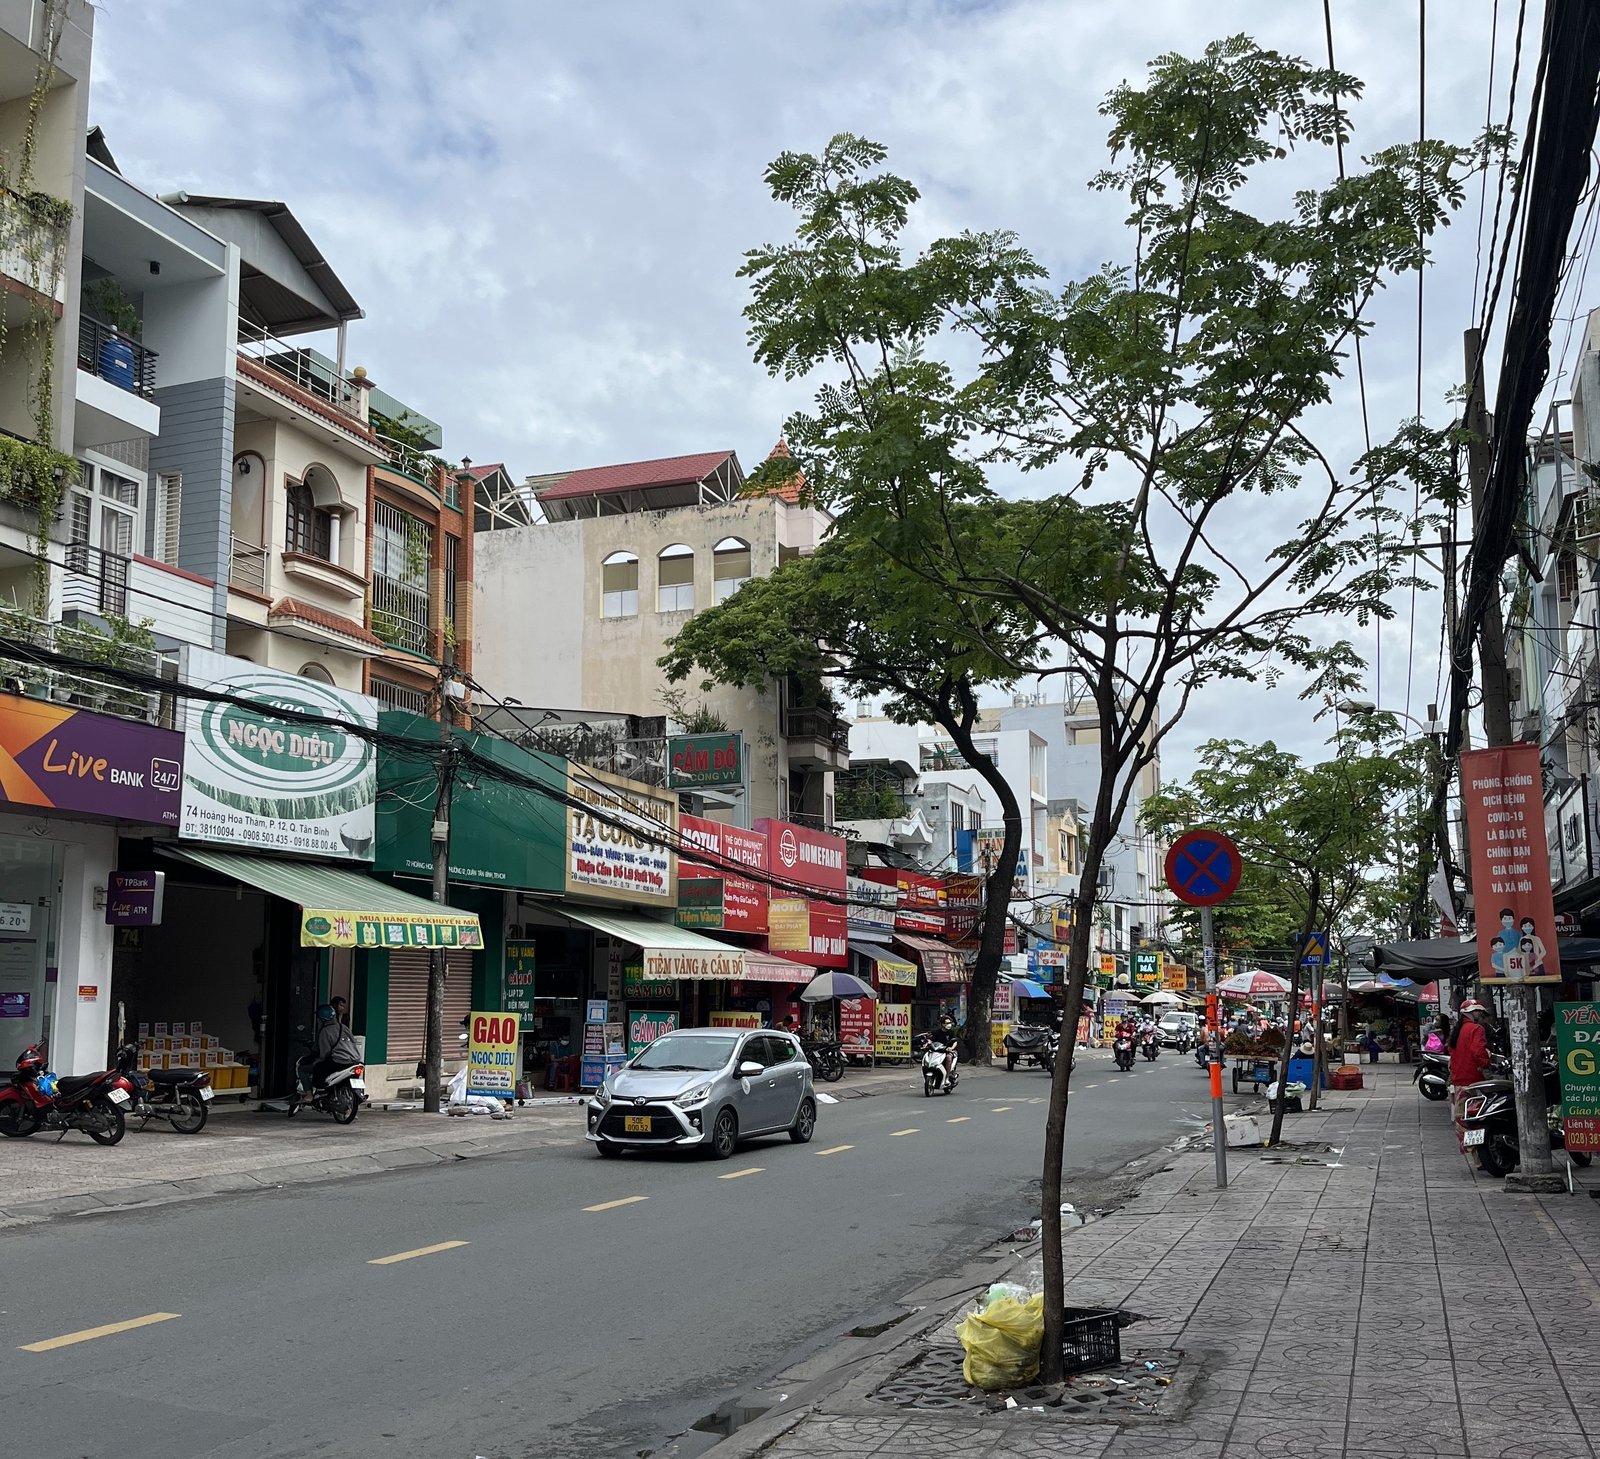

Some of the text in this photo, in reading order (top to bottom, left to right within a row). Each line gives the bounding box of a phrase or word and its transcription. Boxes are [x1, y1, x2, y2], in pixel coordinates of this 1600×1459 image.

[228, 719, 335, 768] NGỌC DIỆU
[43, 738, 145, 788] Live BANK
[673, 741, 737, 772] CẦM ĐỒ
[153, 771, 178, 786] 24/7
[1472, 772, 1533, 790] PHÒNG, CHỐNG
[1482, 792, 1526, 809] DỊCH BỆNH
[186, 804, 198, 817] 74
[200, 809, 226, 824] Hoàng
[227, 813, 243, 825] Hoa
[269, 819, 276, 829] P.
[289, 822, 298, 833] Q.
[299, 824, 312, 834] Tân
[313, 826, 330, 837] Bình
[1487, 811, 1524, 823] COVID-19
[185, 822, 338, 851] ĐT: 38110094 0908.503.435 0918.88.00.46
[680, 827, 720, 853] MOTUL
[1487, 827, 1527, 841] LÀ BẢO VỆ
[572, 842, 587, 854] MUA
[799, 841, 842, 870] HOMEFARM
[1487, 845, 1531, 859] CHÍNH BẠN
[742, 850, 762, 868] PHÁT
[613, 864, 623, 878] Đồ
[1492, 863, 1528, 876] GIA ĐÌNH
[124, 878, 149, 887] TPBank
[1491, 879, 1532, 894] VÀ XÃ HỘI
[133, 906, 147, 914] ATM
[771, 903, 807, 912] MOTUL
[383, 915, 408, 923] HÀNG
[411, 915, 423, 923] CÓ
[679, 907, 721, 925] Tiệm Vàng
[951, 915, 974, 932] TỊNH
[121, 928, 140, 946] 74
[813, 933, 846, 957] NHẬP KHẨU
[647, 952, 743, 978] TIỆM VÀNG & CẦM ĐỒ
[1137, 955, 1156, 963] RAU
[1307, 955, 1321, 963] CHỢ
[1509, 957, 1524, 970] 5K
[624, 963, 643, 980] TIỆ
[1139, 963, 1154, 972] MÁ
[625, 979, 653, 998] CẦM
[655, 980, 673, 998] ĐỒ
[712, 1017, 734, 1027] THAY
[878, 1006, 909, 1027] CẦM ĐỒ
[1561, 1004, 1600, 1025] YẾN
[473, 1016, 516, 1049] GẠO
[471, 1048, 515, 1069] NGỌC DIỆU
[1564, 1083, 1596, 1094] Chuyên
[1565, 1093, 1598, 1103] các loại
[1569, 1105, 1592, 1116] Giao
[1567, 1119, 1596, 1131] Liên hệ:
[1568, 1132, 1588, 1146] (028)
